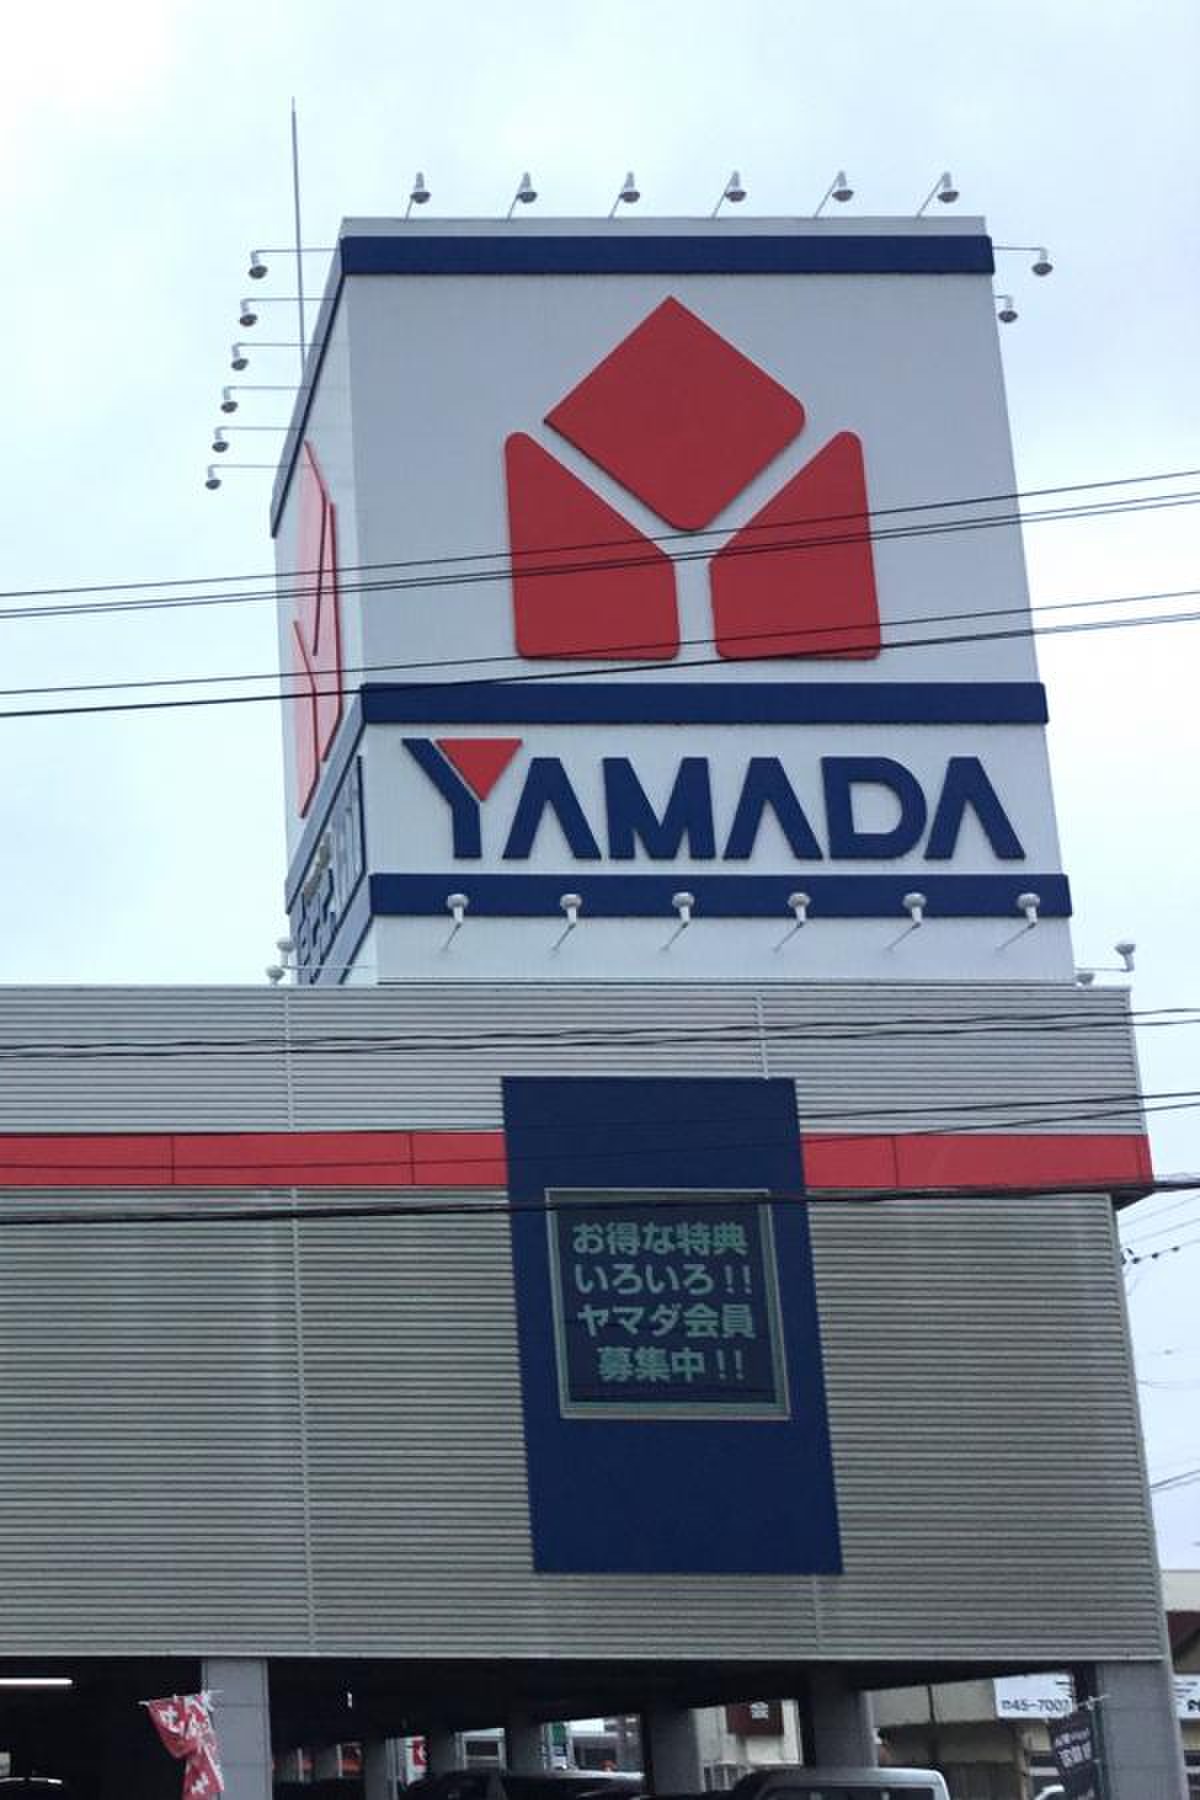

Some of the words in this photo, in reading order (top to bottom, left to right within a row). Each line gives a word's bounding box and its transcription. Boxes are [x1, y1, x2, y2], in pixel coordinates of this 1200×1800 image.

[401, 737, 1026, 860] YAMADA
[573, 1222, 748, 1256] お得な特典
[578, 1303, 756, 1338] ヤマダ会員
[597, 1346, 745, 1382] 募集中!!
